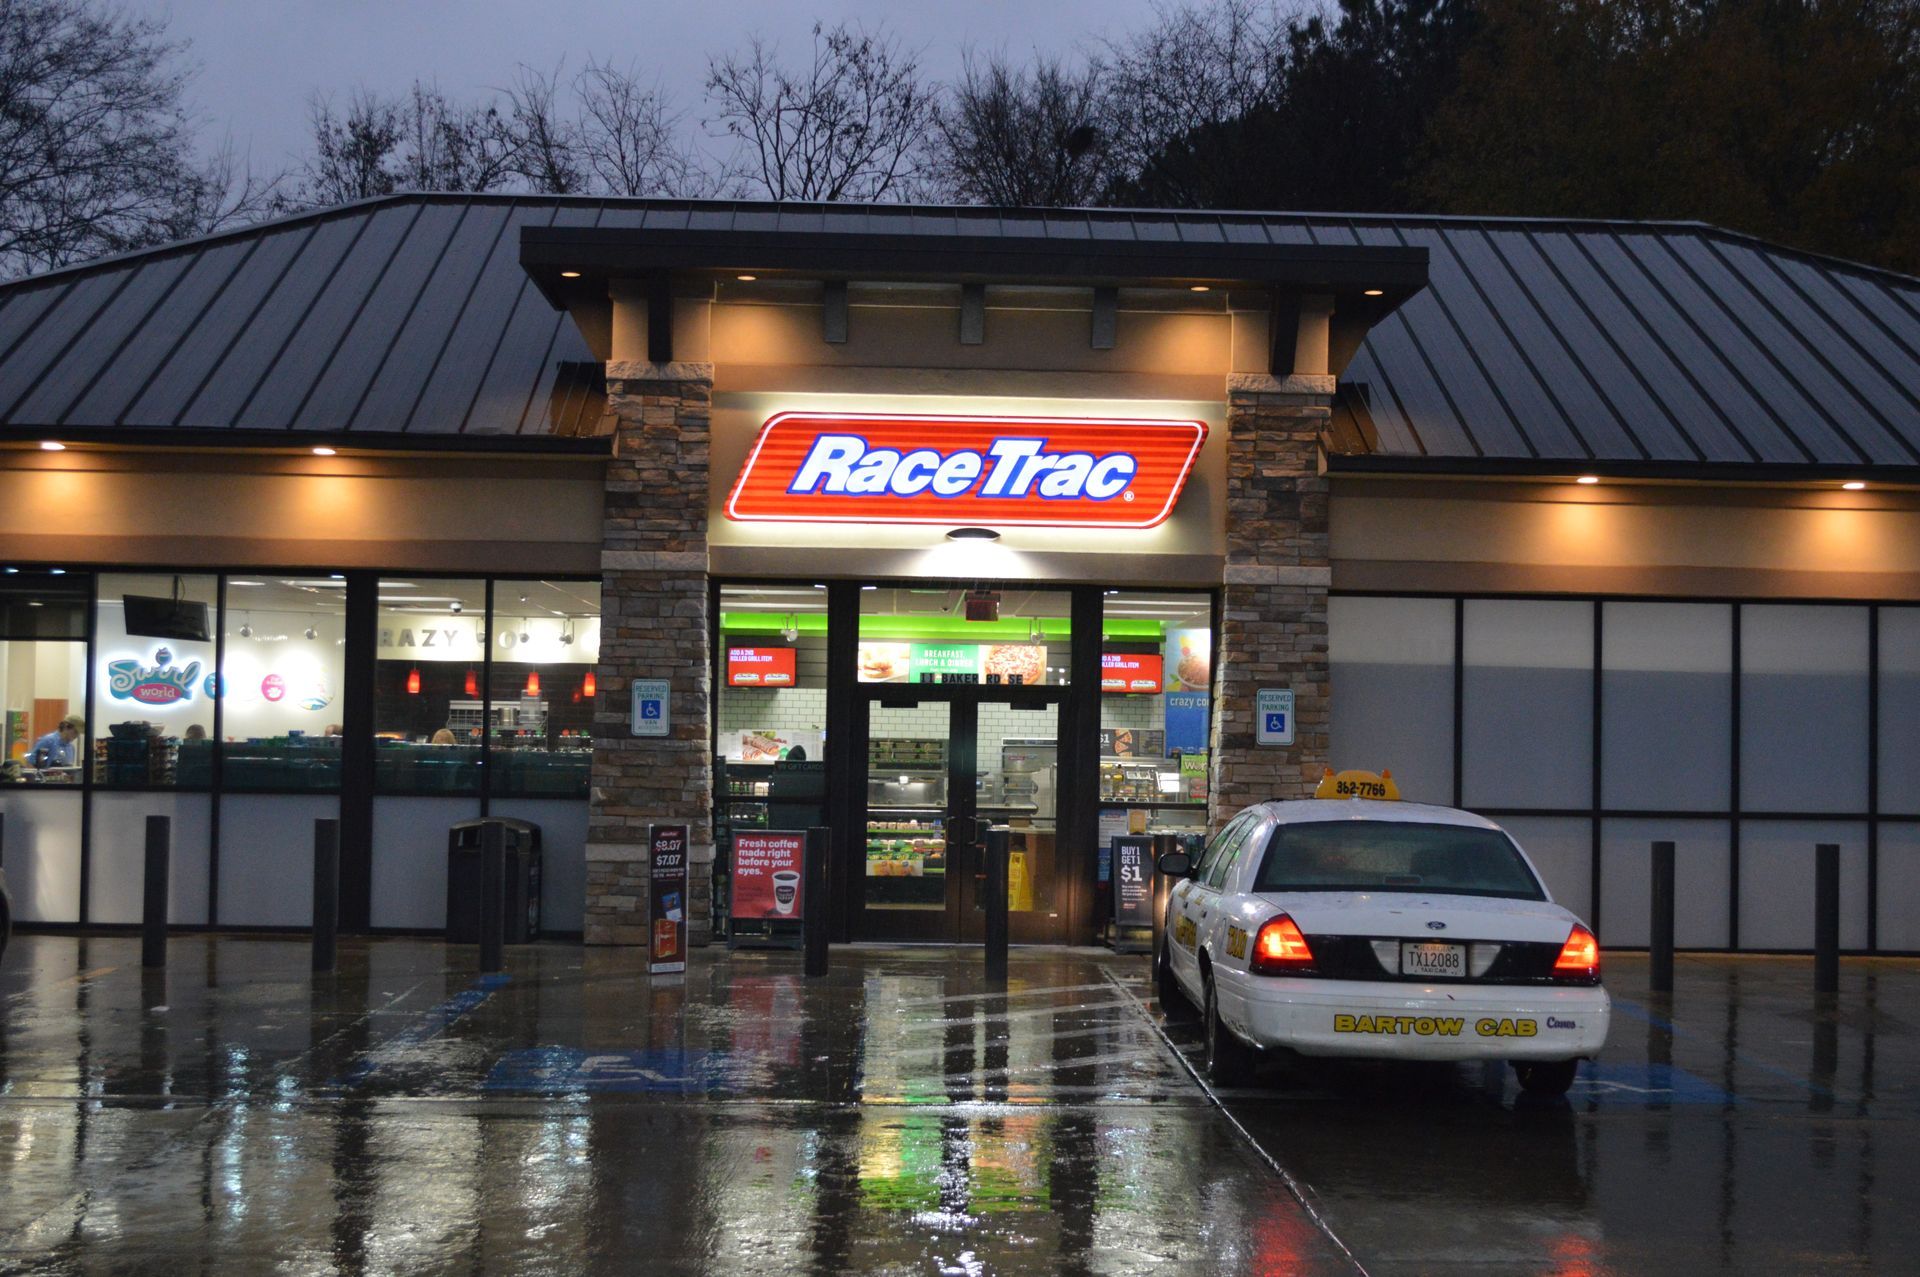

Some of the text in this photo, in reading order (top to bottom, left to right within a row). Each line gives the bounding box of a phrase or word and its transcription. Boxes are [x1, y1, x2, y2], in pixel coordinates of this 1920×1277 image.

[788, 432, 1138, 502] RaceTrac
[378, 628, 458, 648] RAZY
[108, 659, 201, 692] Swirl
[941, 674, 978, 684] BAKER
[986, 675, 1000, 684] RD
[1008, 675, 1023, 684] SE
[140, 685, 175, 698] world
[1170, 698, 1194, 709] crazy
[1336, 781, 1386, 796] 362-7766
[738, 839, 798, 849] Fresh coffee
[738, 849, 791, 859] made right
[1121, 846, 1140, 855] BUY 1
[656, 855, 681, 865] $7.07
[738, 858, 793, 868] before your
[1121, 856, 1140, 864] GET 1
[738, 868, 763, 876] eyes.
[1121, 865, 1142, 882] $1
[1409, 952, 1459, 968] TX12088
[1334, 1014, 1537, 1037] BARTOW CAB
